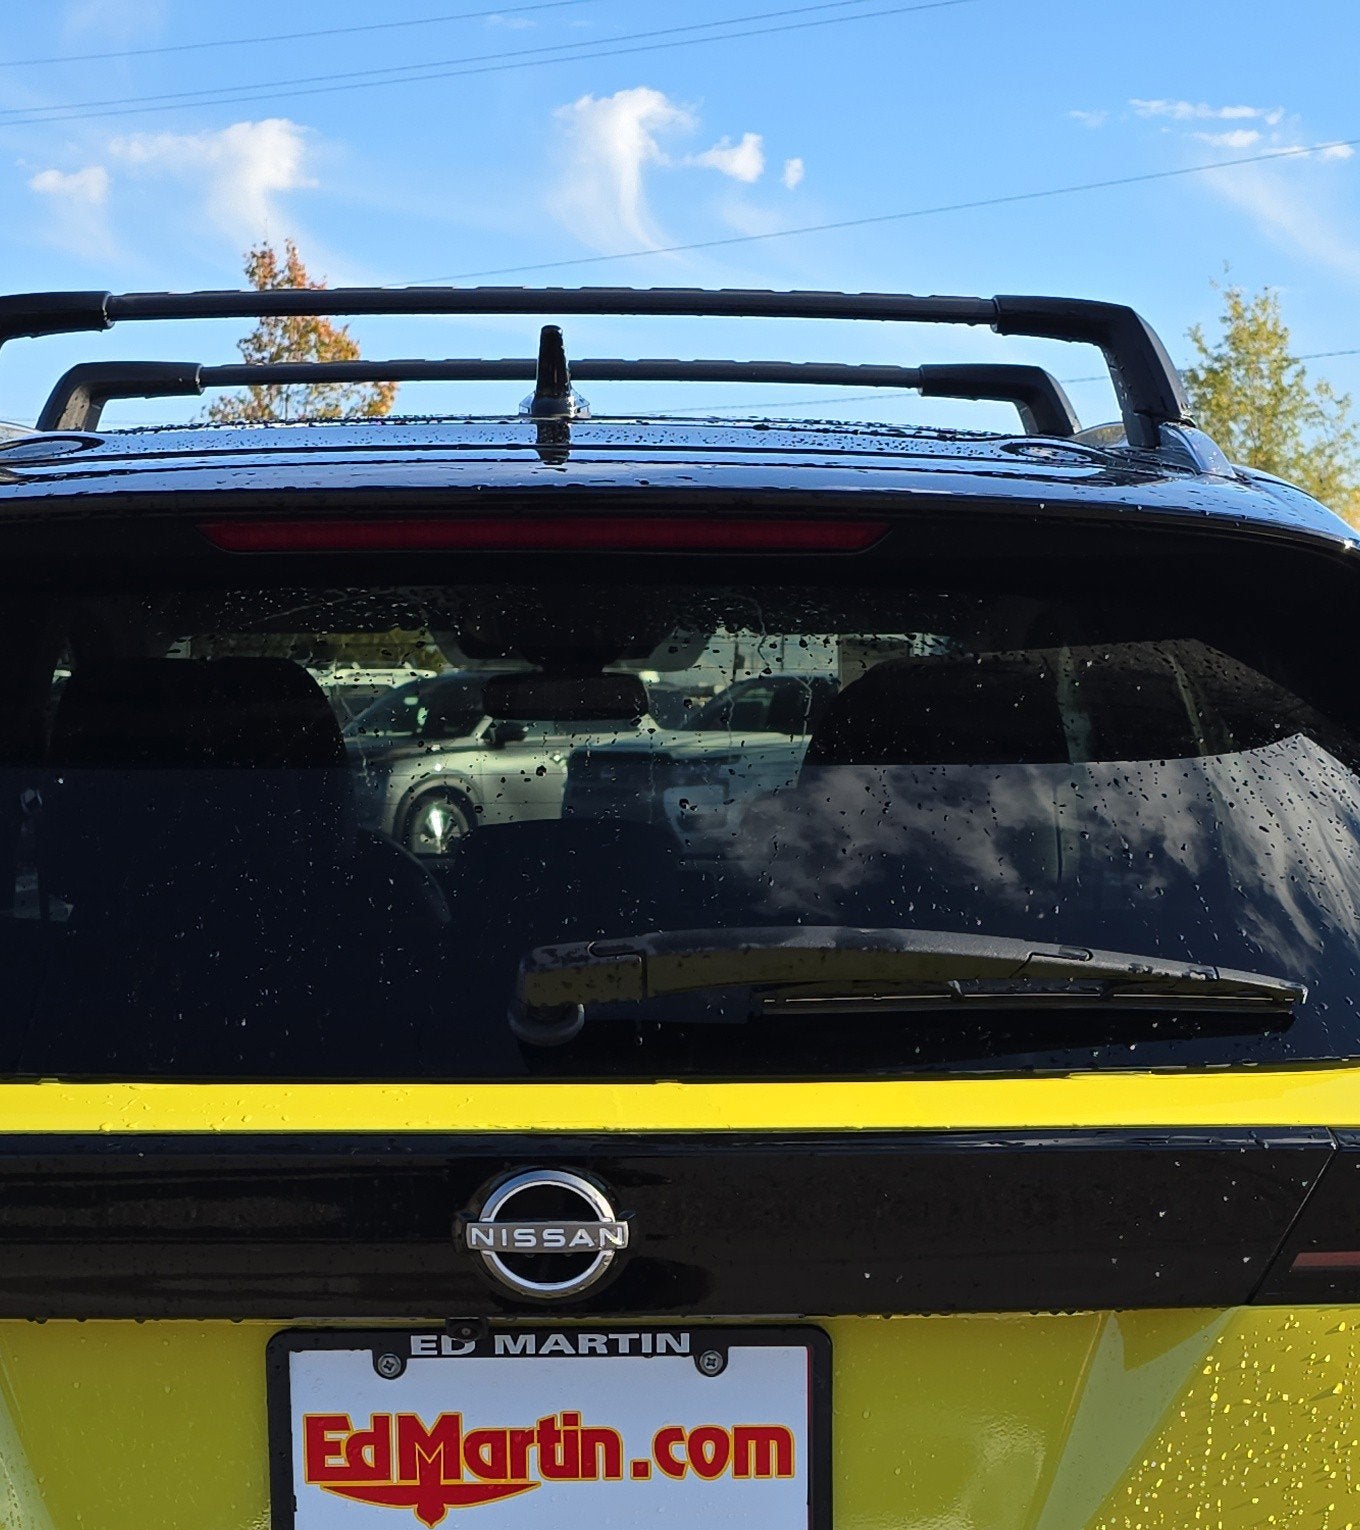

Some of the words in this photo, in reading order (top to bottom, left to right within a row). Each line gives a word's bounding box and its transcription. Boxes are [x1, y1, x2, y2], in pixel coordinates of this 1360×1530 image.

[470, 1226, 625, 1249] NISSAN
[410, 1334, 476, 1356] ED
[494, 1332, 690, 1355] MARTIN
